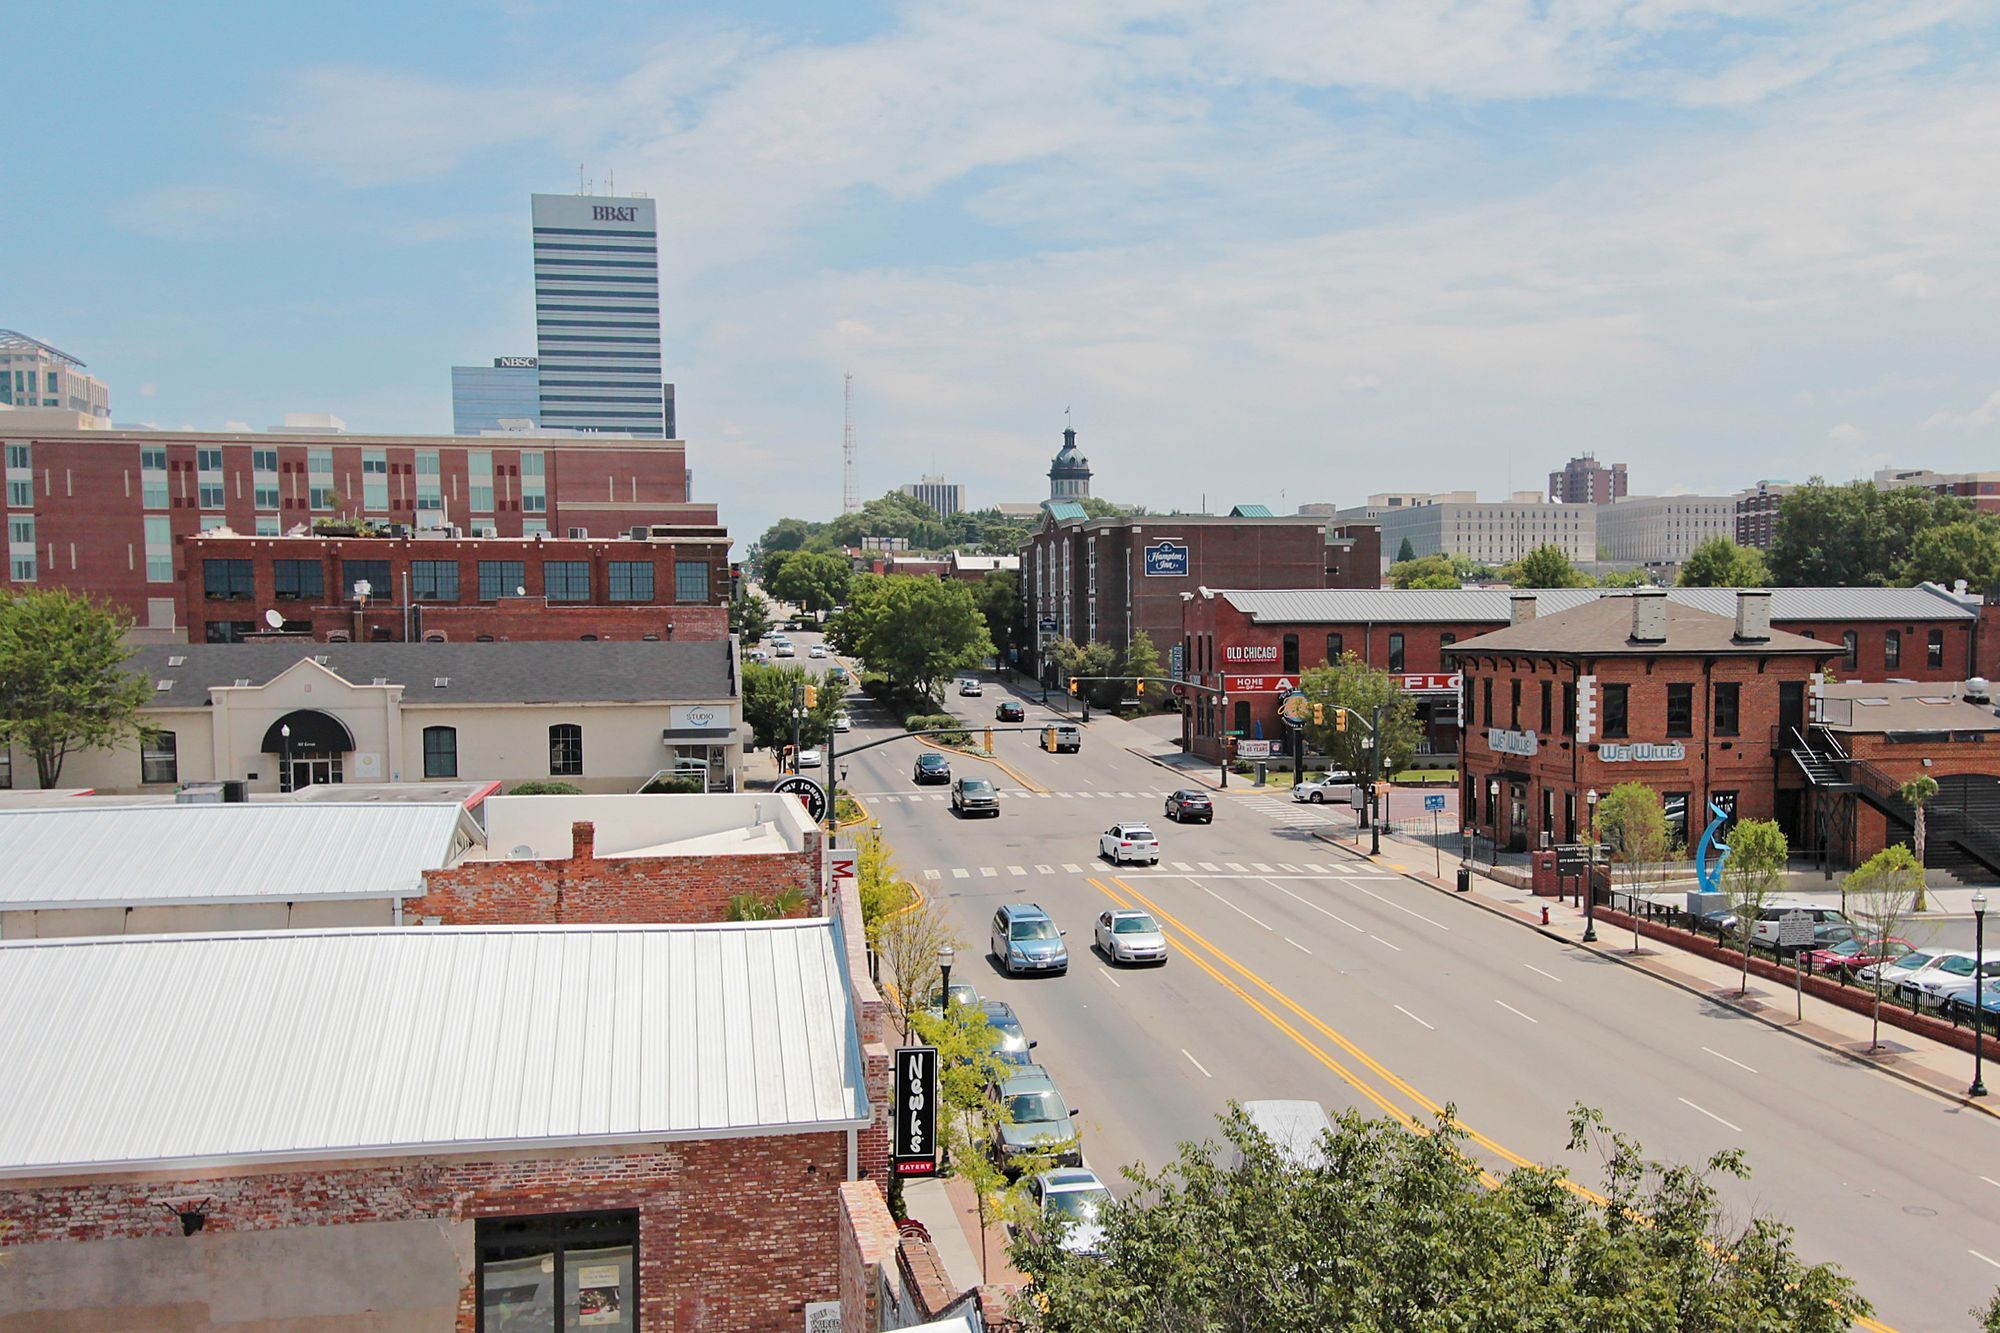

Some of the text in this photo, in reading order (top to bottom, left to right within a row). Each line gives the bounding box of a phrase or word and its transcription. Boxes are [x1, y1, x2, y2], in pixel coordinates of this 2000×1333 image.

[592, 206, 638, 221] BB&T
[501, 358, 534, 366] NBSC
[1148, 551, 1185, 562] Hampton
[1156, 560, 1175, 570] Inn
[1227, 647, 1277, 658] OLD CHICAGO
[1601, 745, 1631, 760] WET
